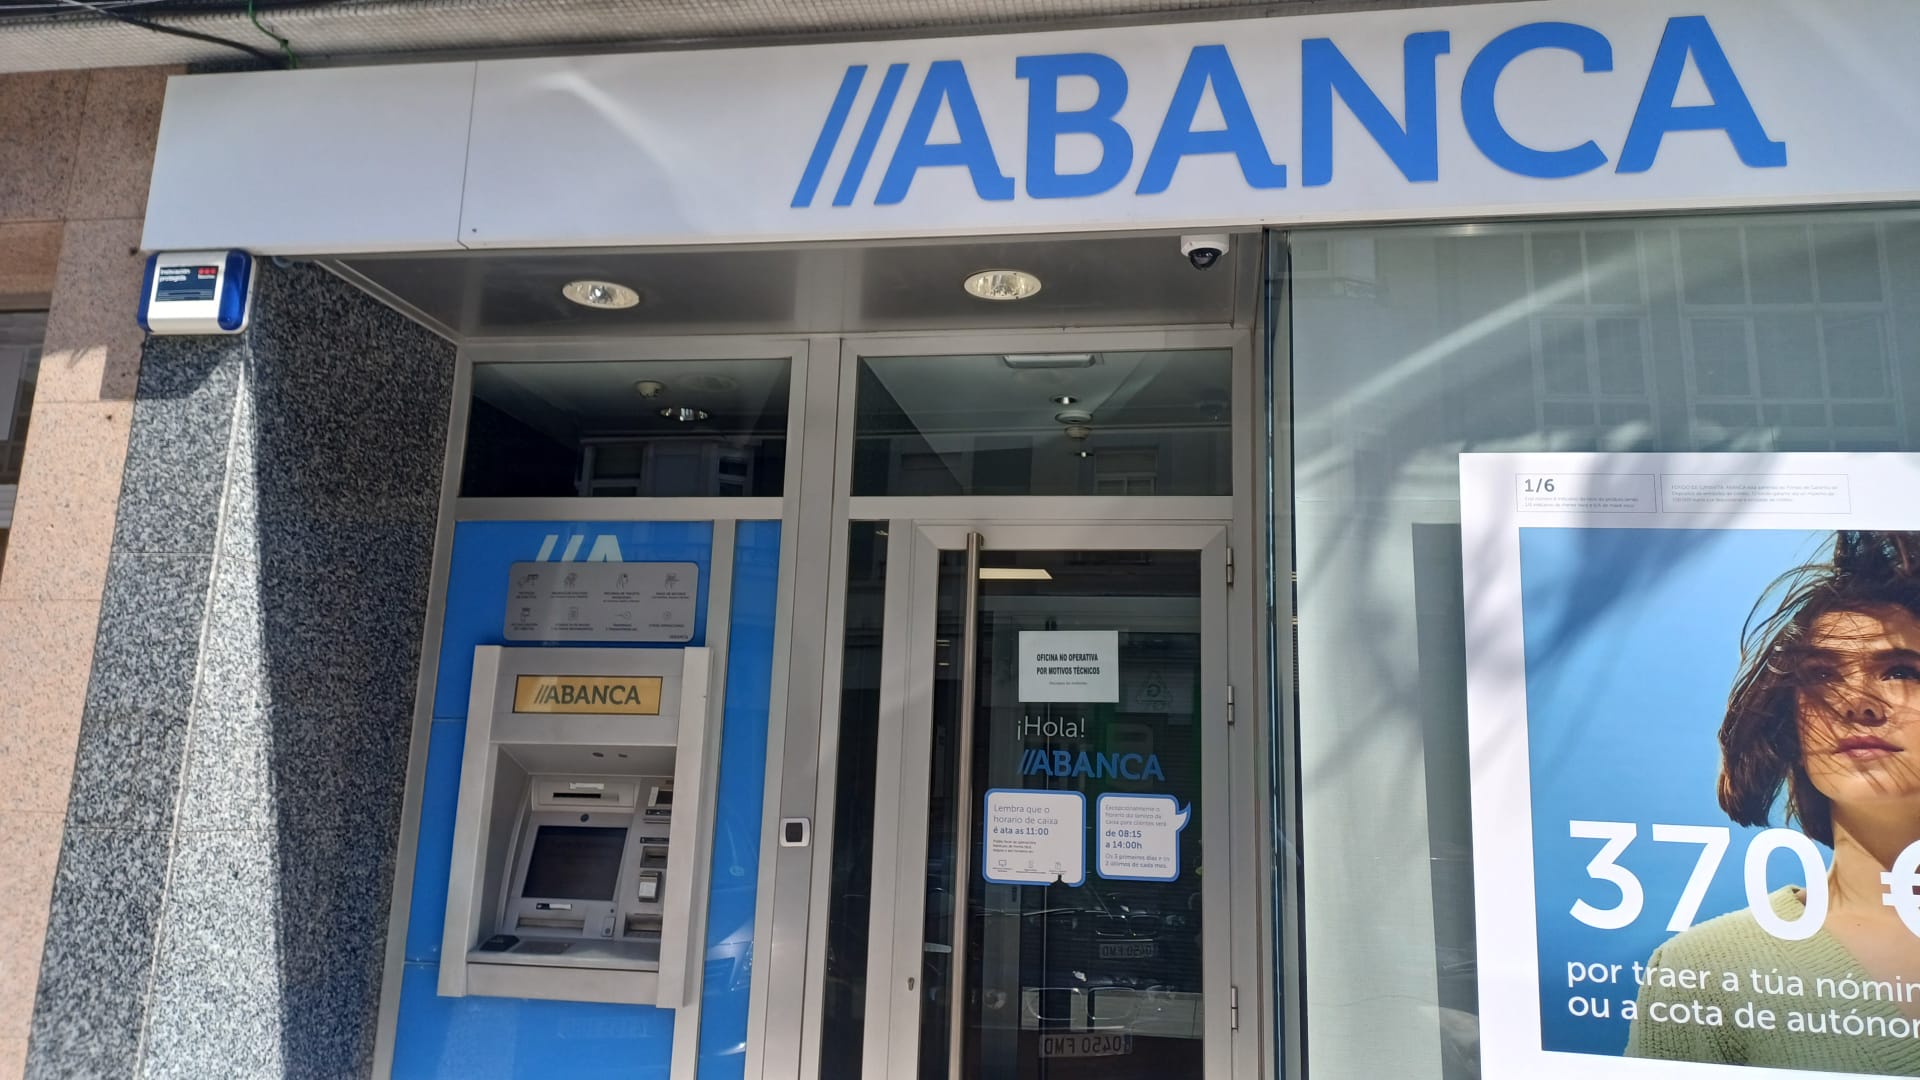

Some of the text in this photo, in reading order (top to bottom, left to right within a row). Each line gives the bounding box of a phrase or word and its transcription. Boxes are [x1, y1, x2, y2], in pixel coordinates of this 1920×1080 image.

[1524, 478, 1555, 493] 1/6
[1036, 653, 1098, 661] OFICINA NO OPERATIVA
[1036, 665, 1100, 675] POR MOTIVOS TÉCNICOS
[1017, 715, 1085, 741] ¡Hola!
[993, 804, 1025, 813] Lembra
[1026, 806, 1042, 814] que
[993, 815, 1059, 825] horario de caixa
[1026, 827, 1049, 836] 11:00
[1105, 829, 1142, 839] de 08:15
[1112, 840, 1143, 850] 14:00h
[1568, 819, 1830, 942] 370
[1567, 961, 1622, 988] por
[1632, 961, 1711, 990] traer
[1722, 971, 1740, 992] a
[1750, 968, 1804, 997] túa
[1568, 996, 1920, 1039] ou a cota de autóno
